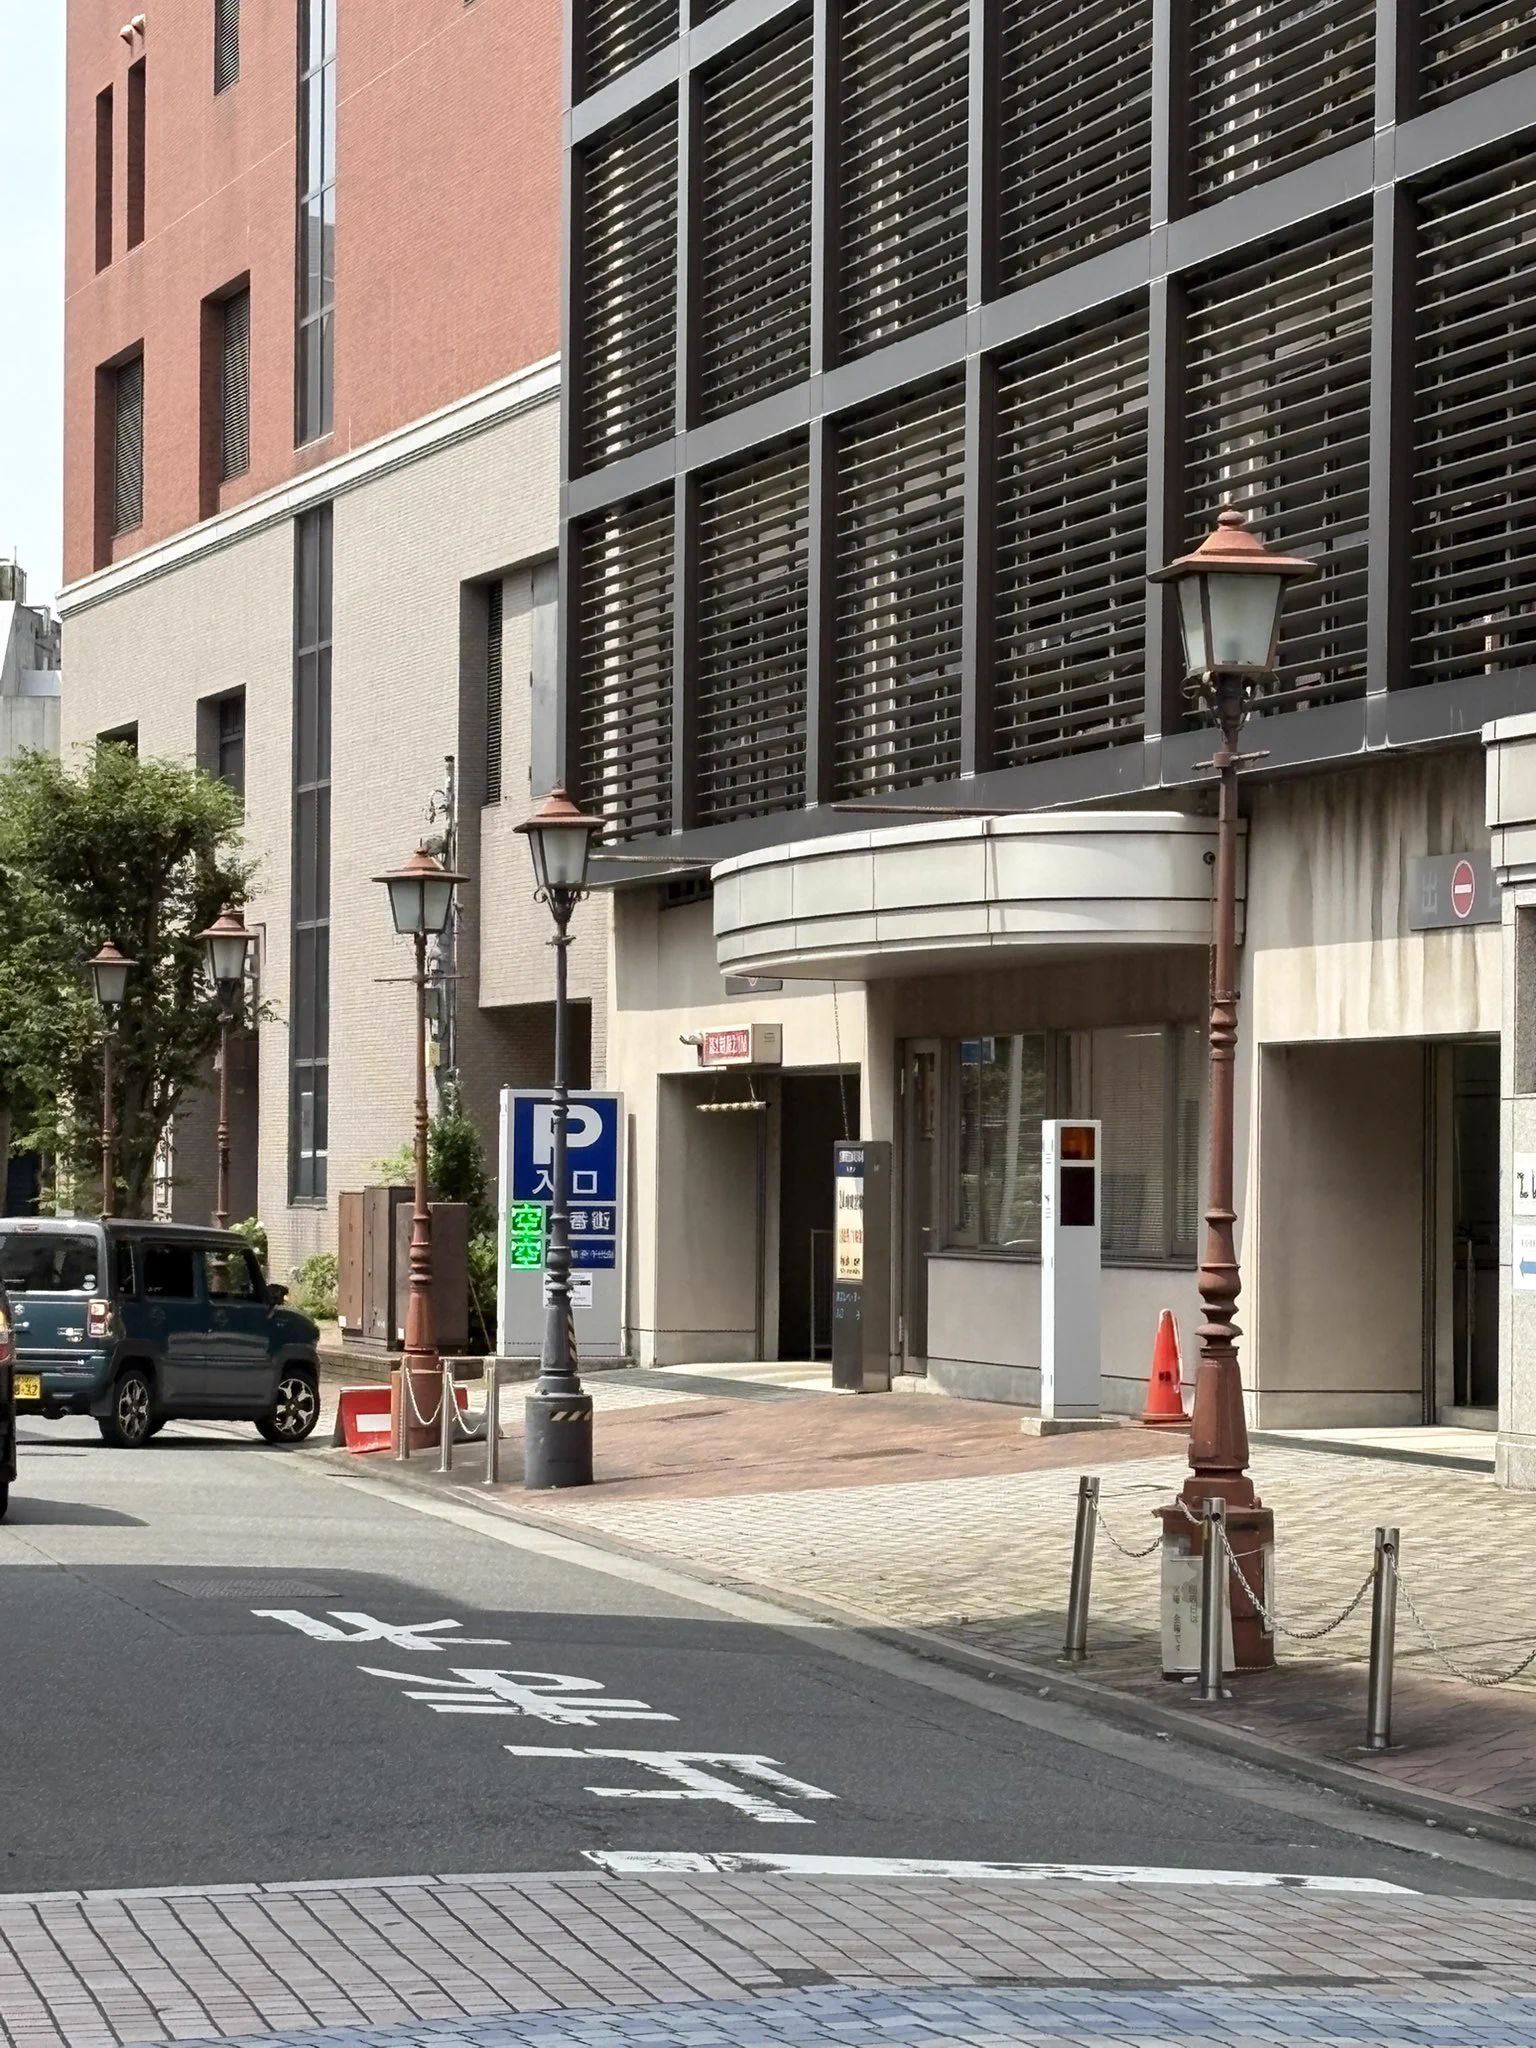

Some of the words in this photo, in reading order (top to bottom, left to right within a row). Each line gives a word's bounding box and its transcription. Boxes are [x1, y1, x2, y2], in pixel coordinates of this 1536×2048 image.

[532, 1104, 603, 1165] P
[532, 1170, 598, 1194] 入口
[511, 1203, 542, 1236] 空
[570, 1211, 610, 1230] 番街
[511, 1238, 542, 1269] 空
[250, 1609, 841, 1824] 止まれ
